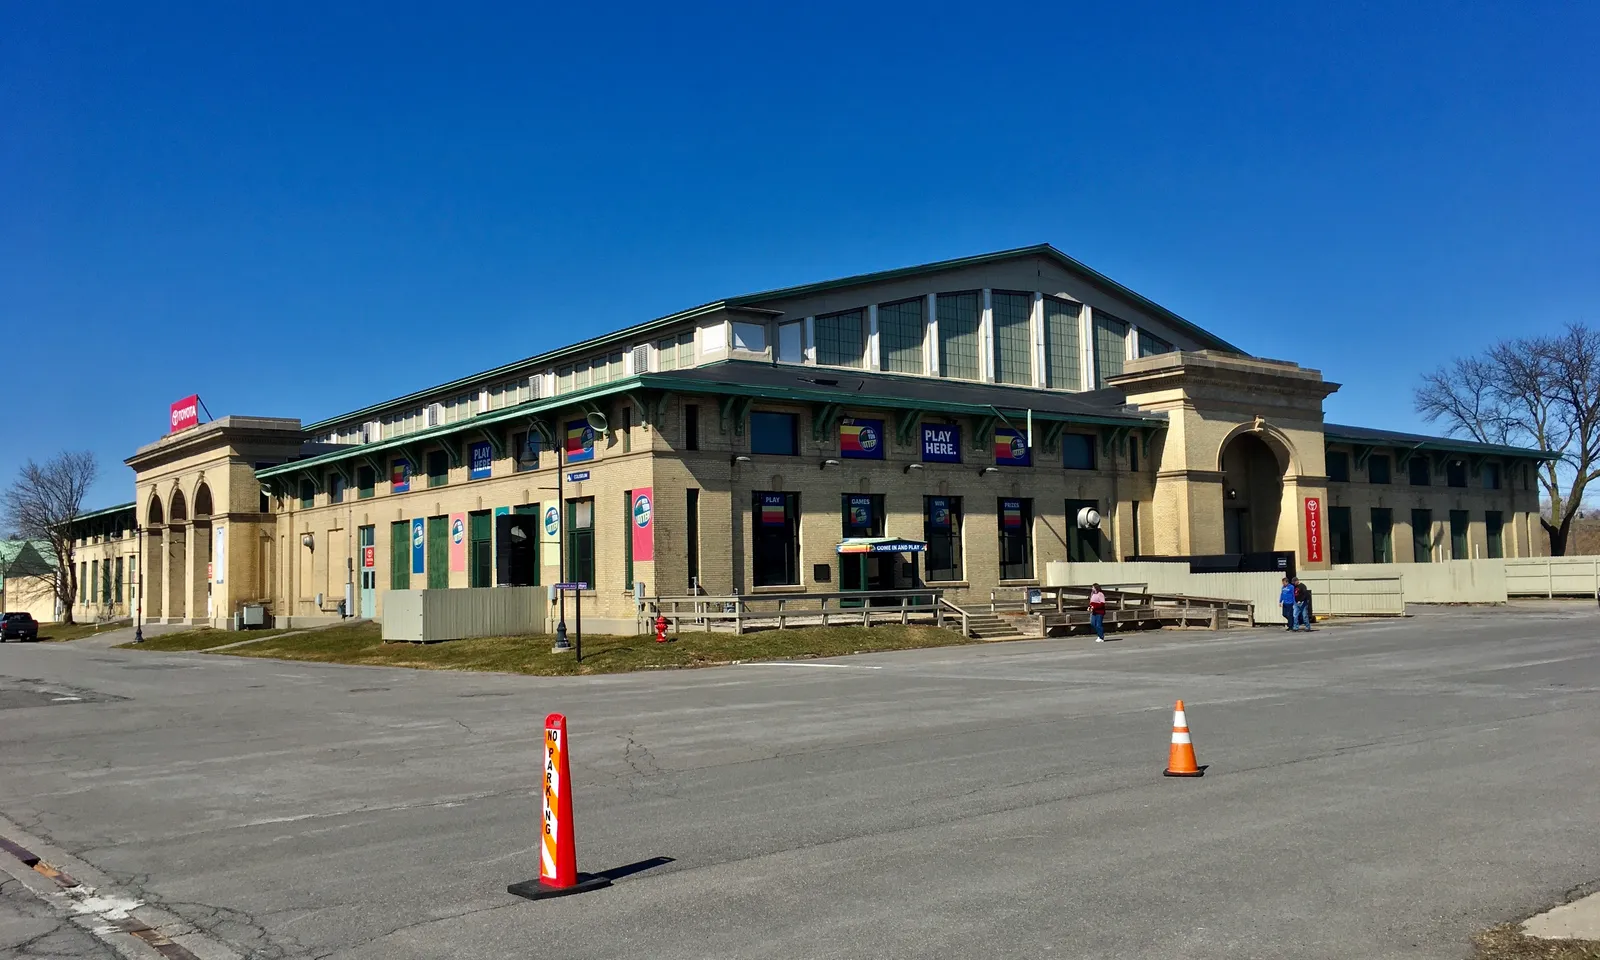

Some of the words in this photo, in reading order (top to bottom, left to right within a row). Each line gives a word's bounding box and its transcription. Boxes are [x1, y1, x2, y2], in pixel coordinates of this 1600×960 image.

[178, 405, 197, 422] TOYOTA
[925, 430, 952, 443] PLAY
[474, 447, 491, 460] PLAY
[925, 443, 957, 455] HERE.
[474, 459, 491, 473] HERE
[765, 496, 780, 504] PLAY
[1310, 512, 1318, 560] TOYOTA
[547, 730, 558, 742] NO
[545, 747, 554, 835] PARKING
